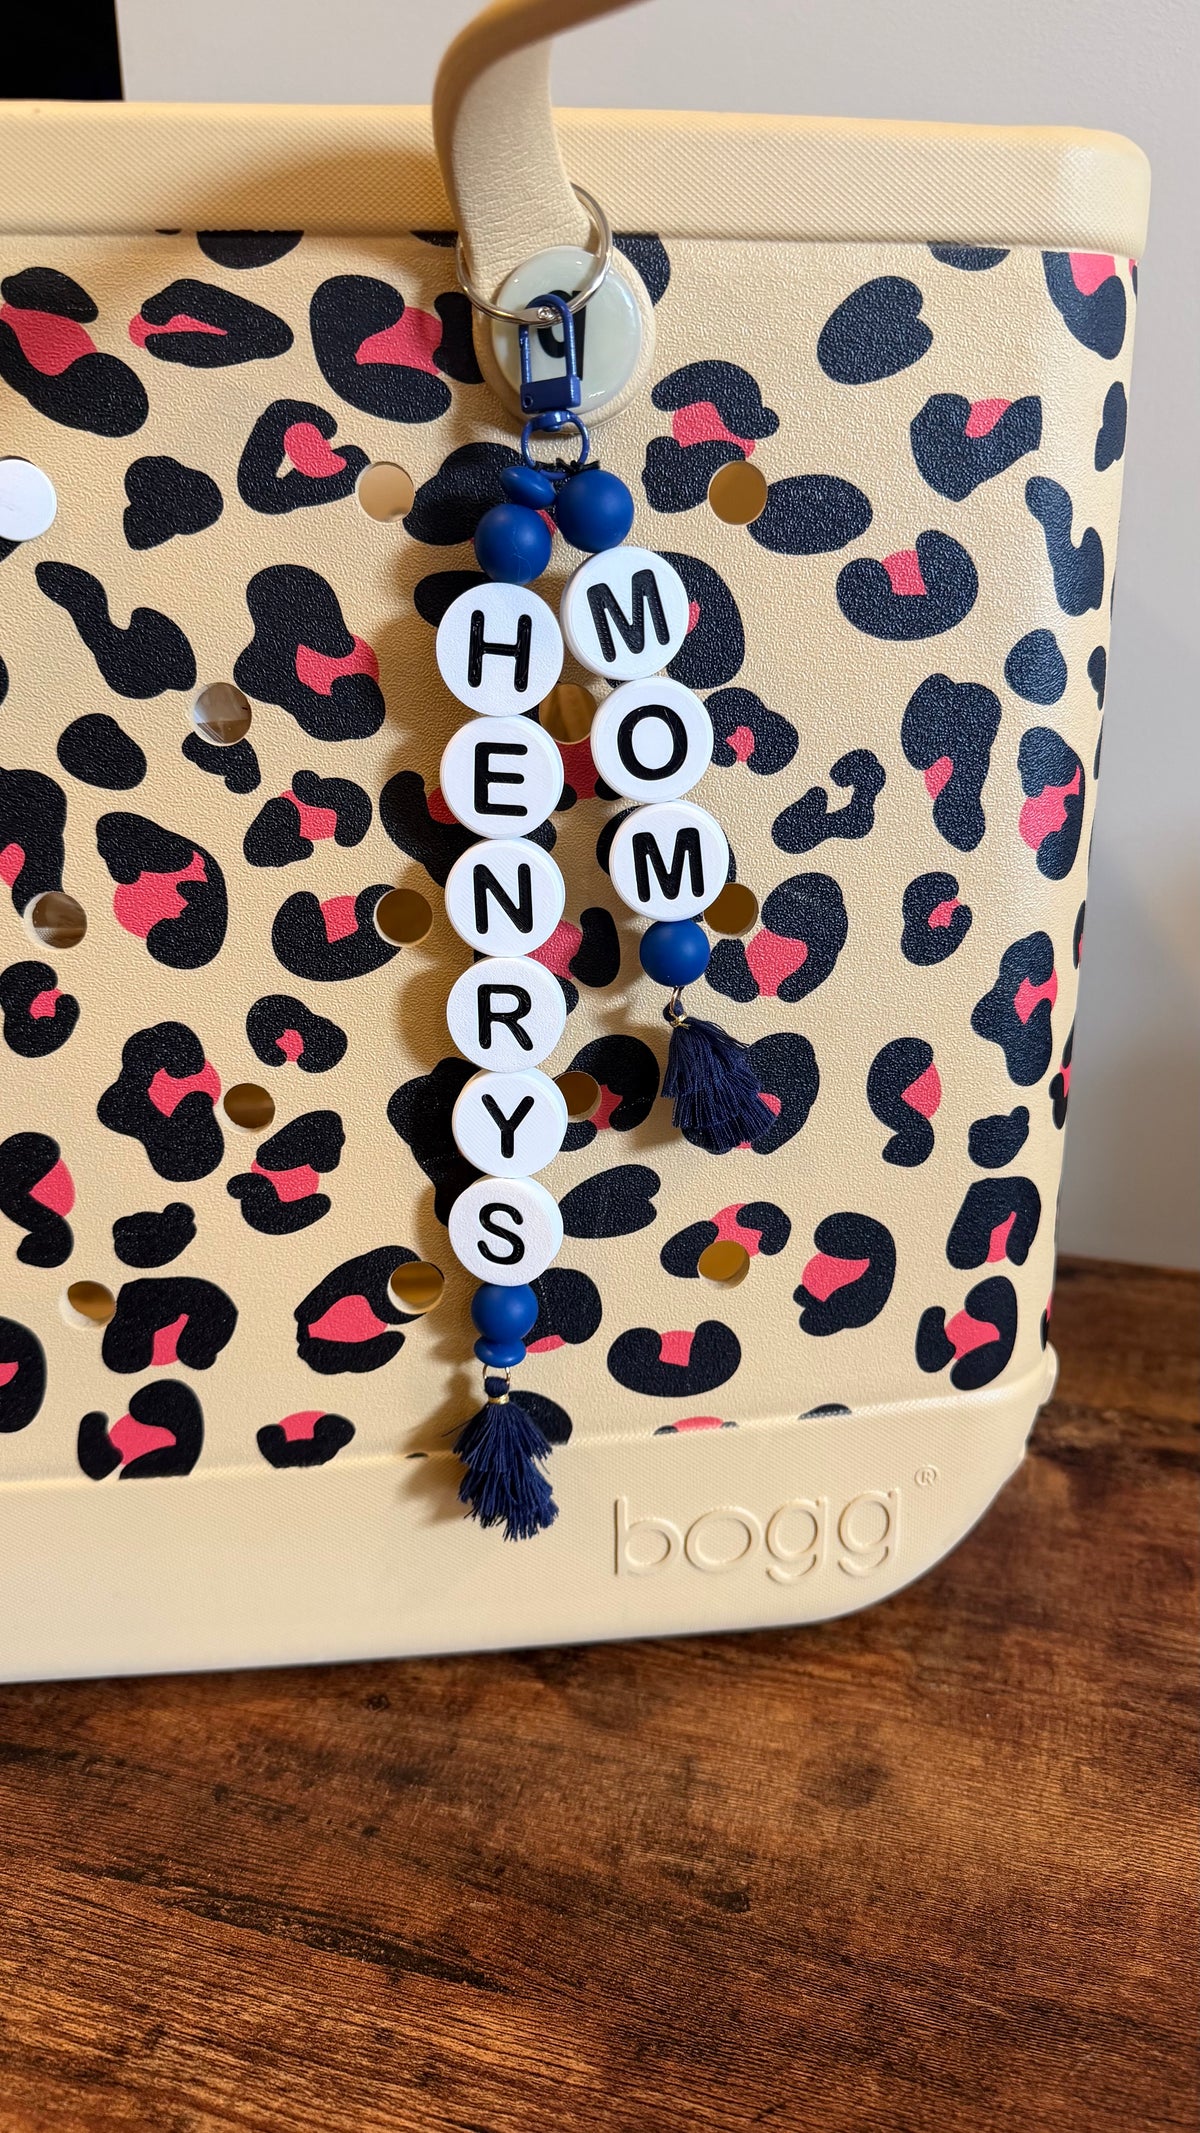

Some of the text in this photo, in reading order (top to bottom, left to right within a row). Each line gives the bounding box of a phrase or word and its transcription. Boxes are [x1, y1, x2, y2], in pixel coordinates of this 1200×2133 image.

[586, 567, 705, 903] MOM
[466, 607, 550, 1266] HENRYS
[613, 1489, 901, 1585] bogg
